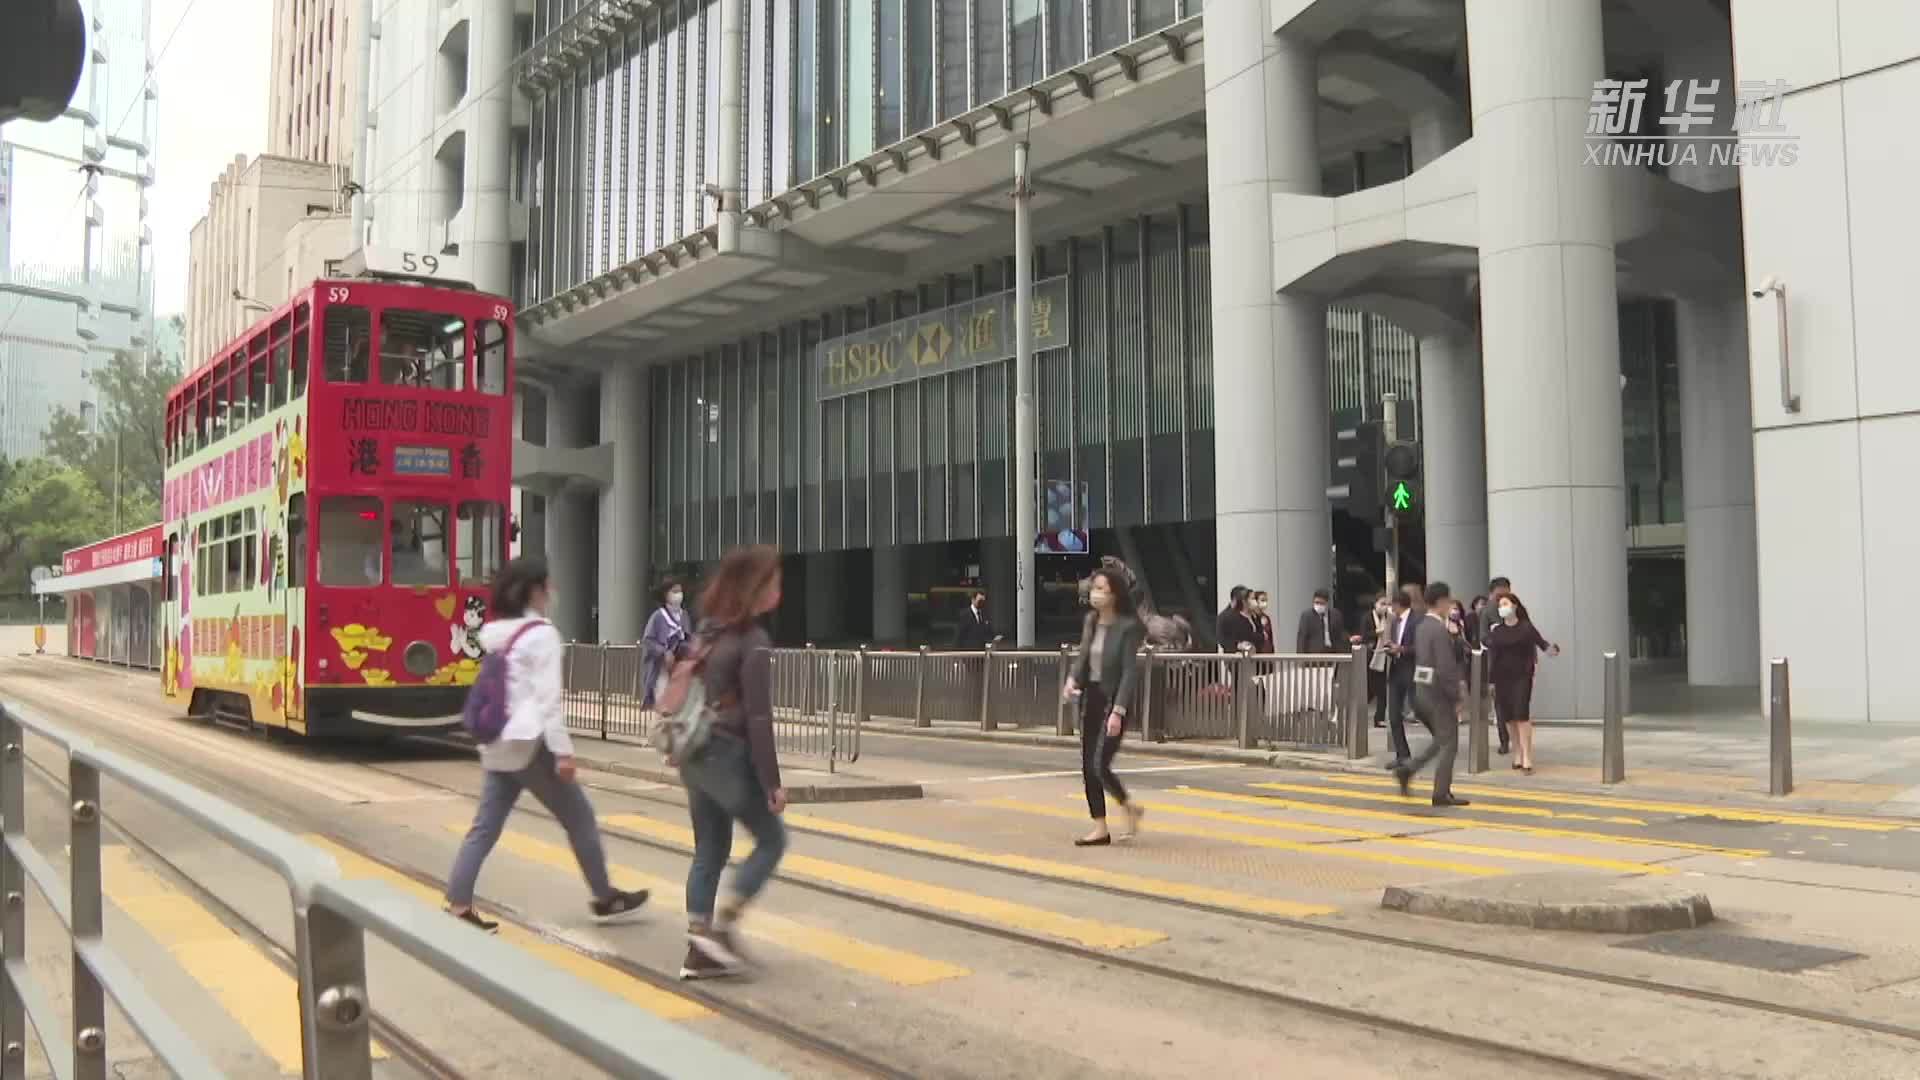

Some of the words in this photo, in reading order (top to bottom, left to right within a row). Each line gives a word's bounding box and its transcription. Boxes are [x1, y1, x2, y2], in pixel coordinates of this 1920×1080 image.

[402, 252, 439, 275] 59
[328, 287, 349, 303] 59
[494, 304, 508, 321] 59
[827, 334, 903, 386] HSBC
[342, 398, 417, 432] HONG
[424, 401, 490, 439] KONG
